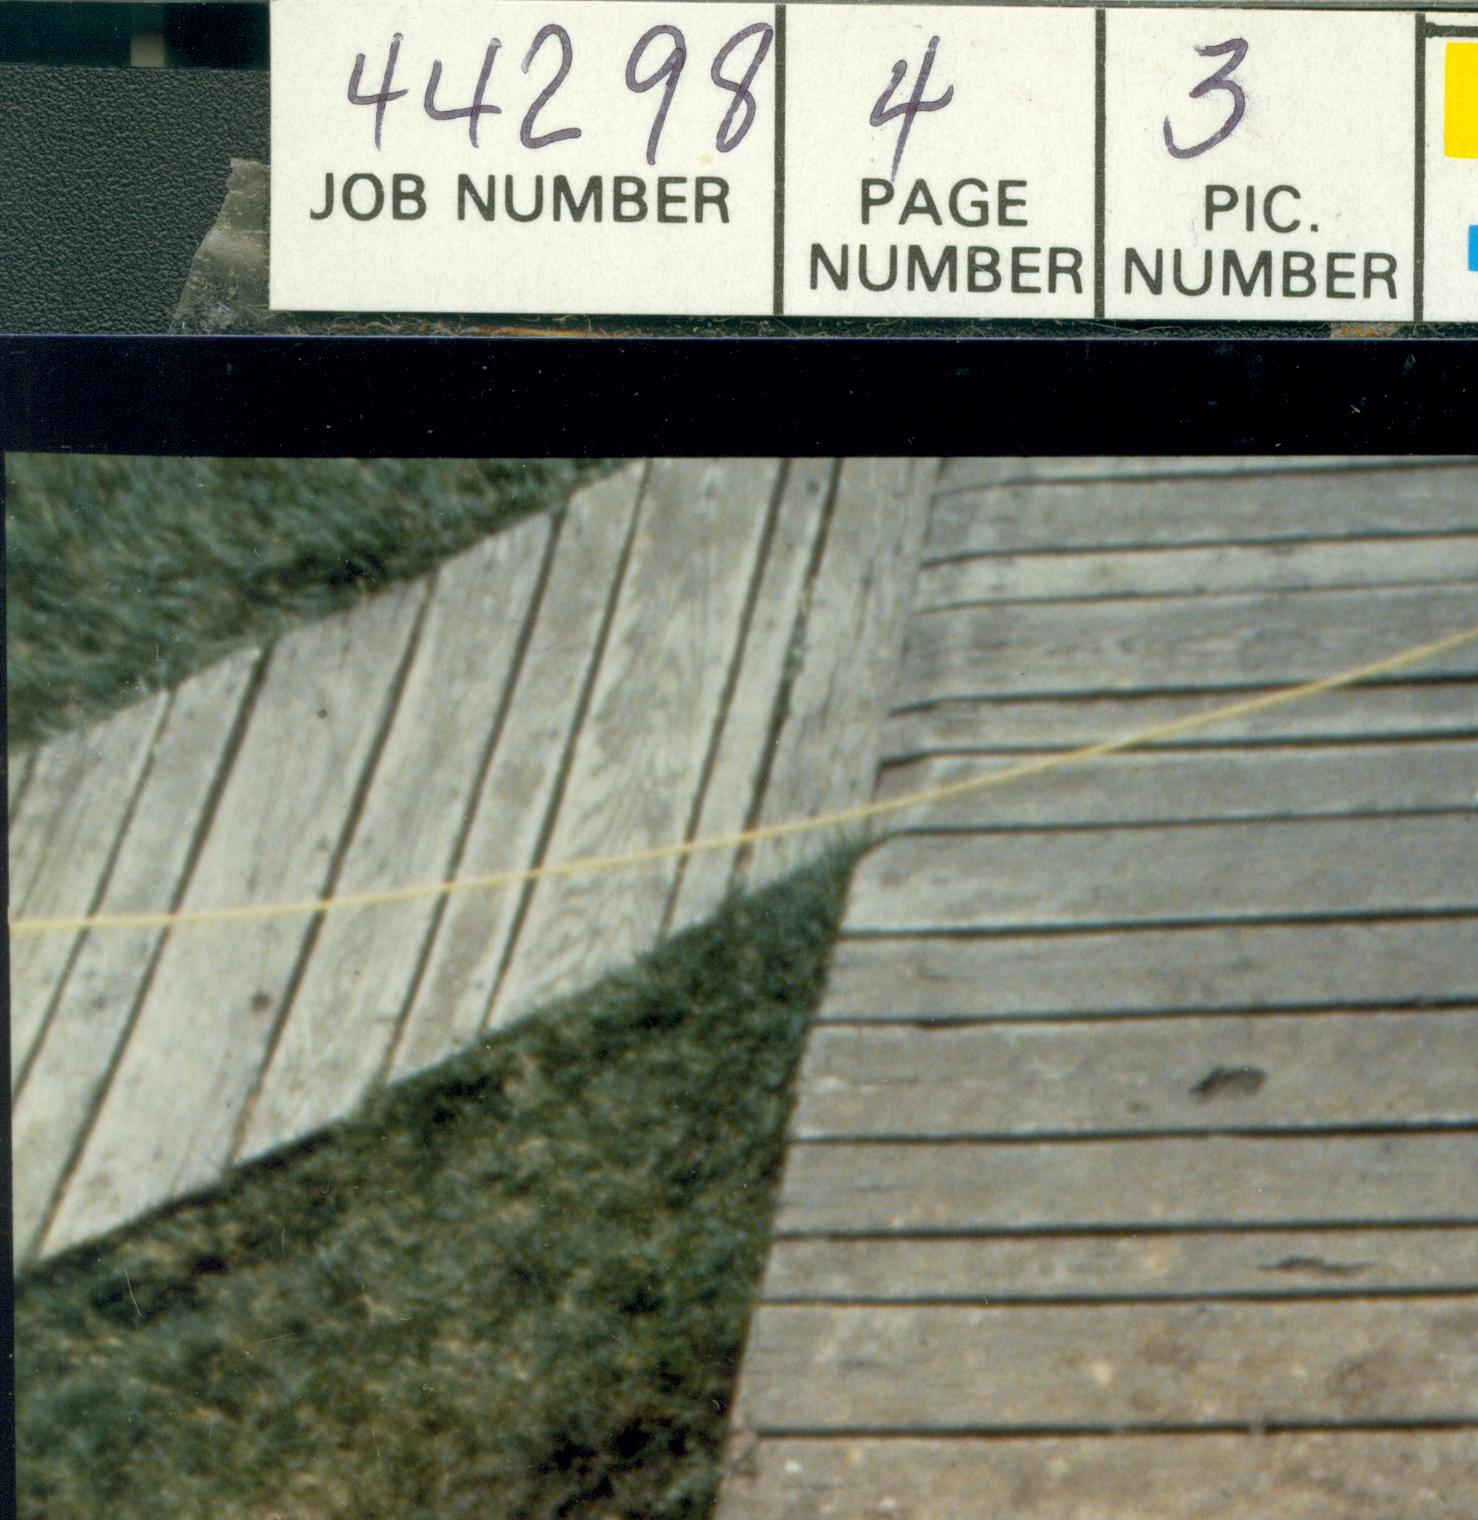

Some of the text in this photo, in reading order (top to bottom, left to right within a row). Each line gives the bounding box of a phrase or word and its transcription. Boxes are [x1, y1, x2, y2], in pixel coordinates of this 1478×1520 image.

[346, 21, 774, 166] 44298
[870, 35, 954, 182] 4
[1163, 37, 1249, 159] 3
[310, 173, 730, 224] JOB NUMBER
[861, 178, 1028, 227] PAGE
[1204, 184, 1320, 234] PIC.
[810, 243, 1083, 295] NUMBER
[1124, 248, 1398, 300] NUMBER
